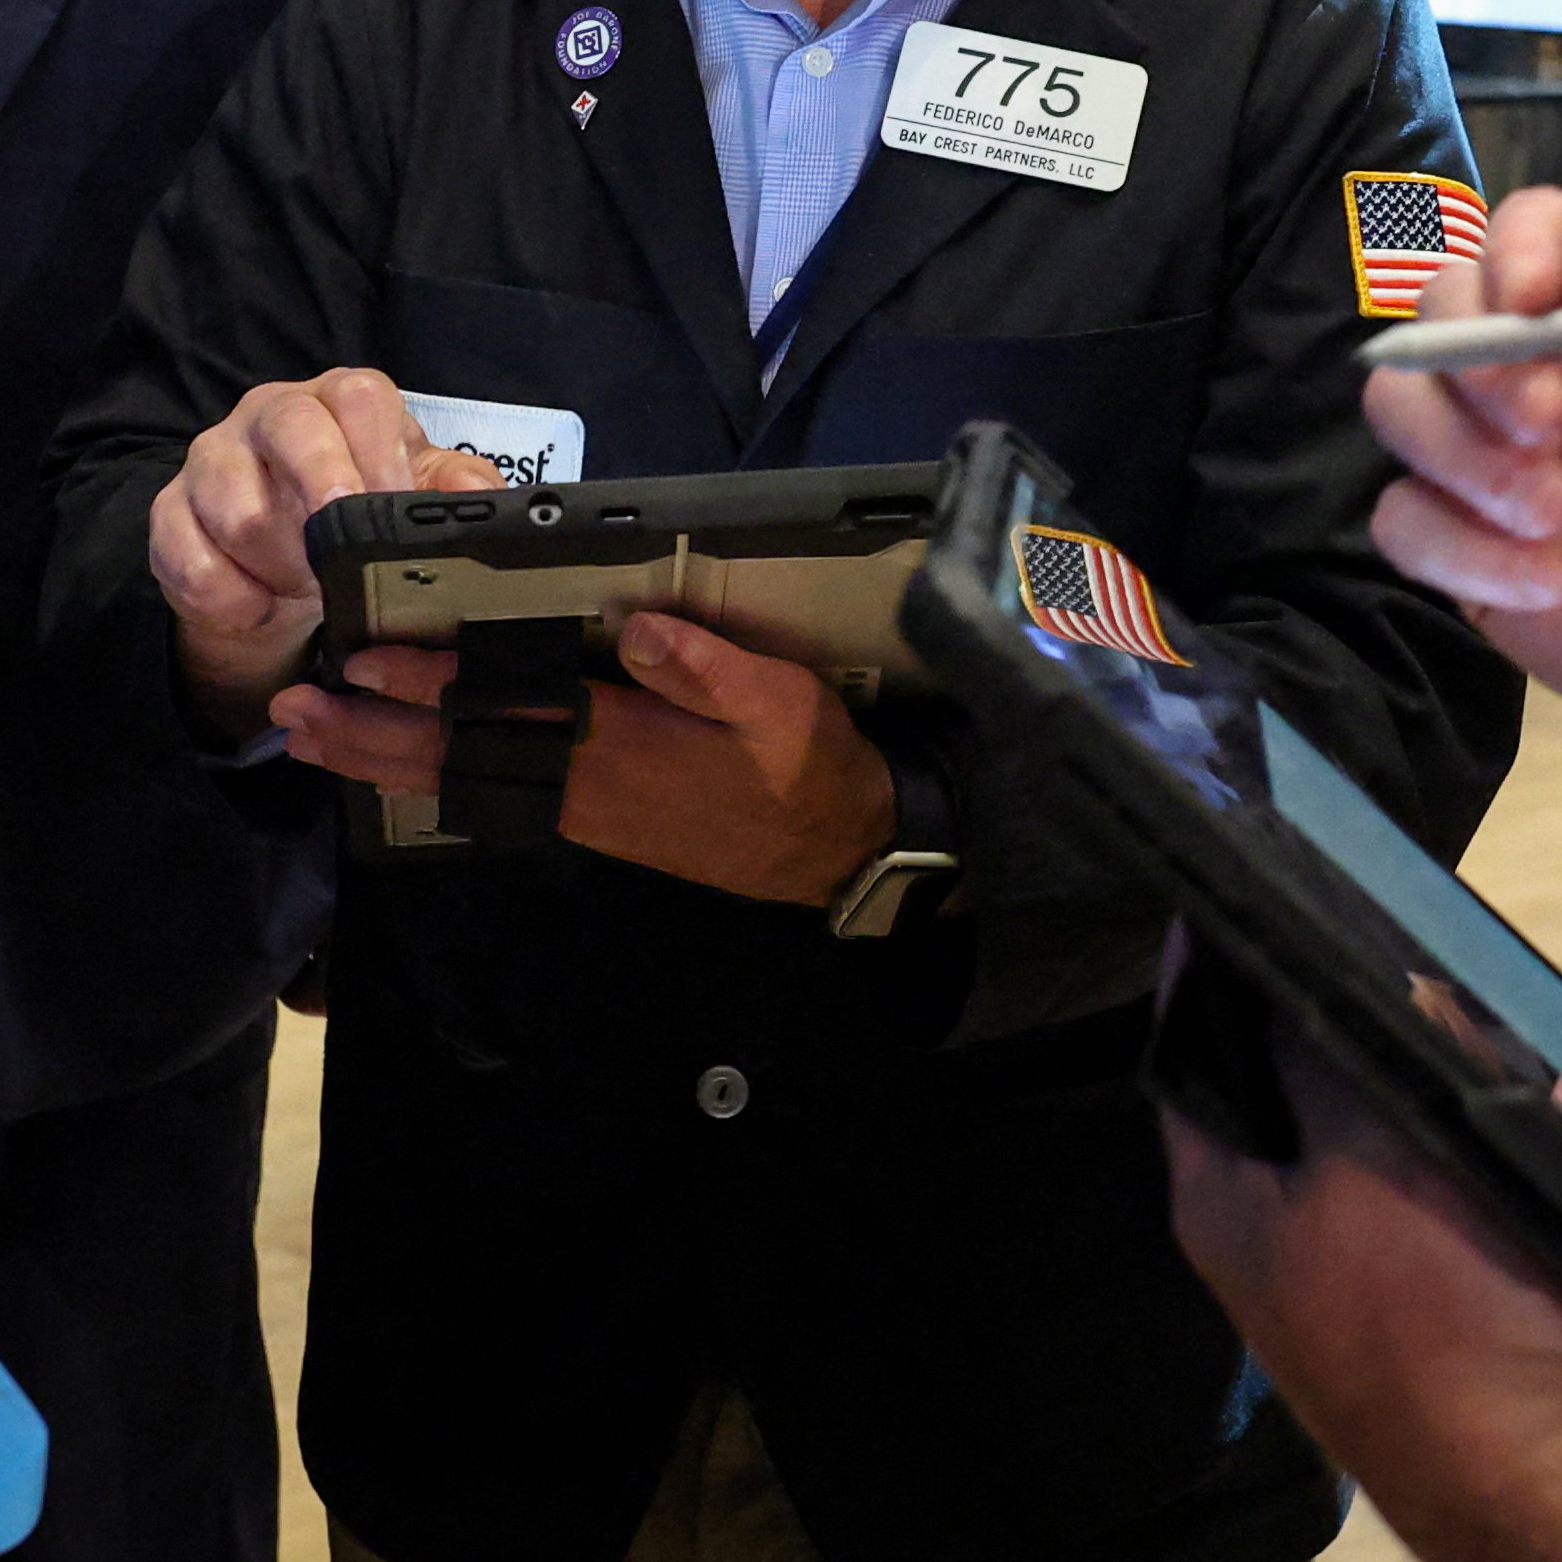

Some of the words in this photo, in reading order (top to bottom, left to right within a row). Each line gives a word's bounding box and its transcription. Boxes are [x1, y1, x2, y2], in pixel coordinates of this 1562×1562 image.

[556, 32, 608, 76] FOUNDATION
[572, 11, 590, 25] JOE
[595, 12, 620, 51] BARONE
[954, 47, 1085, 118] 775
[923, 102, 1003, 131] FEDERICO
[1014, 120, 1095, 150] DeMARCO
[899, 129, 927, 146] BAY
[934, 136, 977, 156] CREST
[1069, 163, 1095, 180] LLC
[454, 442, 550, 486] est
